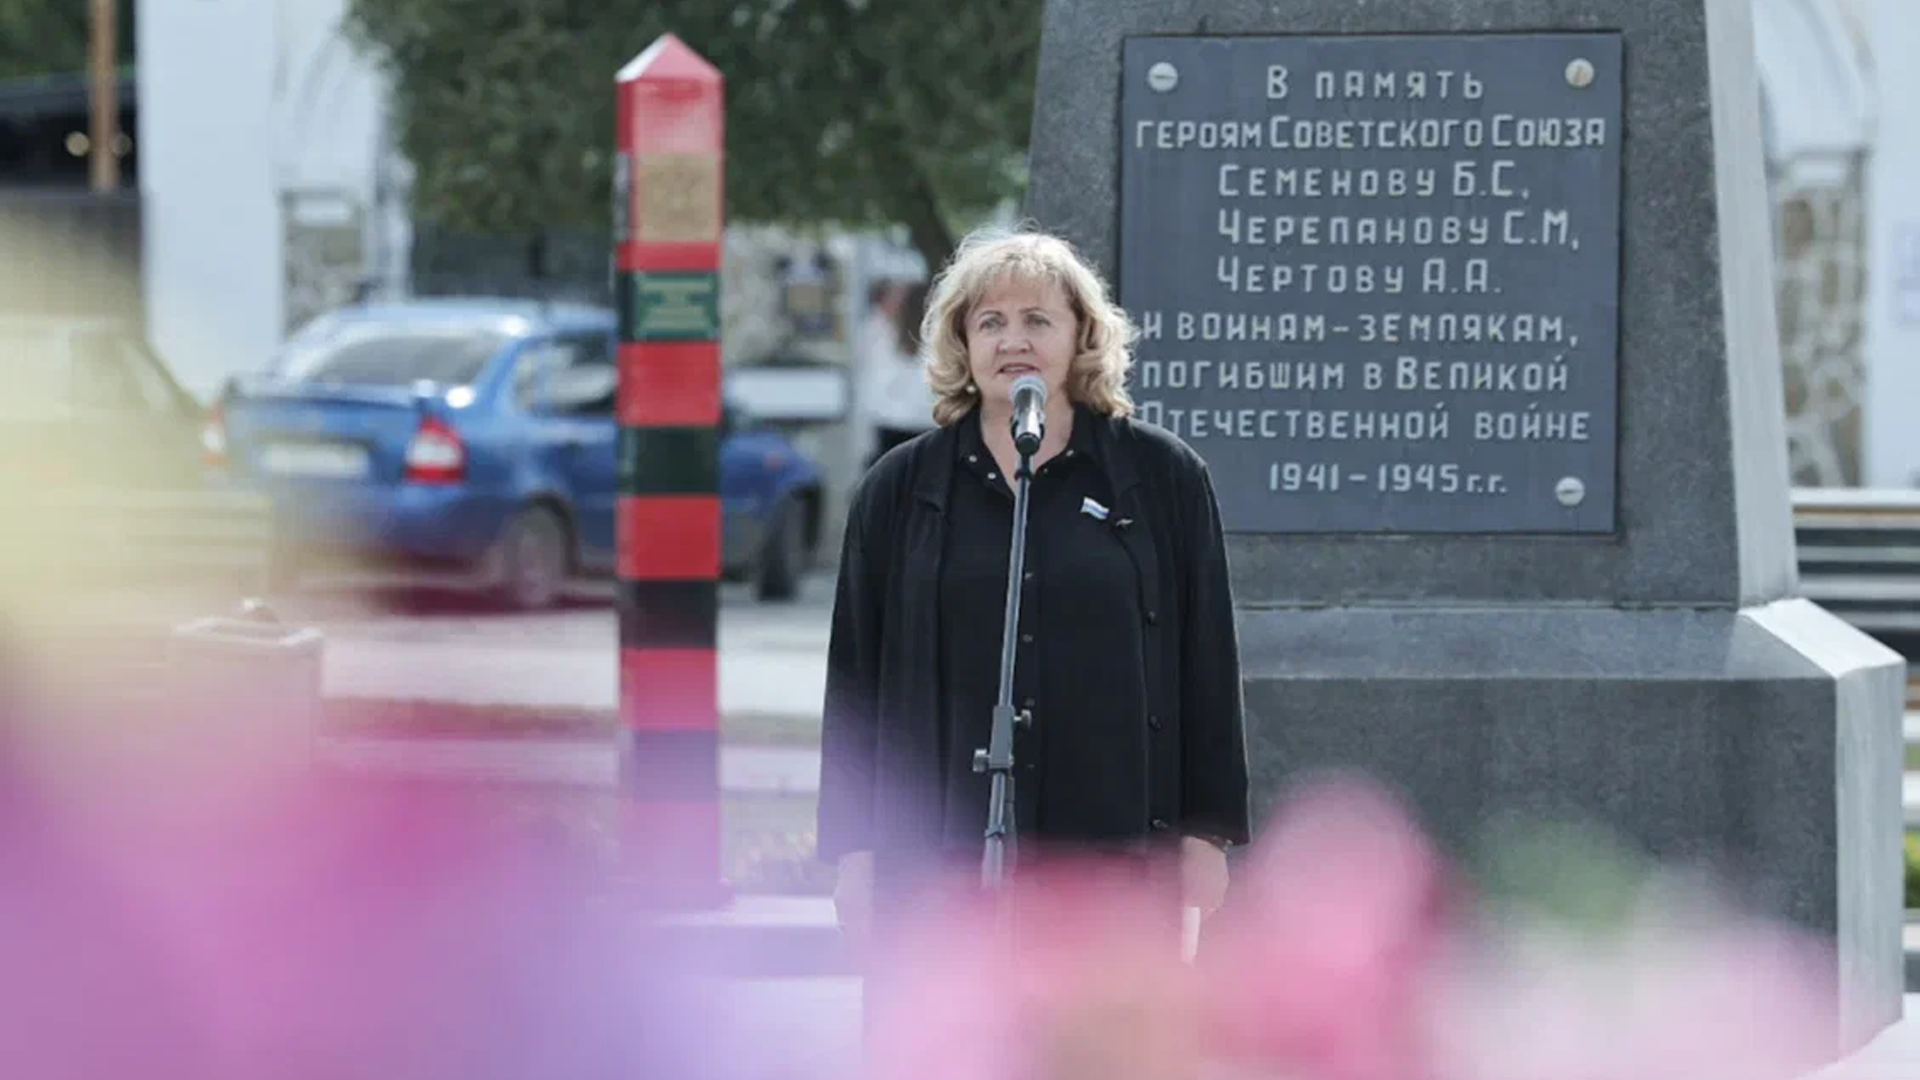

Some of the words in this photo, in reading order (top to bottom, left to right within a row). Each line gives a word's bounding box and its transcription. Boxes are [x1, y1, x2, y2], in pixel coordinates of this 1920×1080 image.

[1266, 64, 1288, 99] В
[1315, 70, 1483, 99] ПАМЯТЬ
[1135, 119, 1262, 149] ГЕРОЯМ
[1269, 113, 1484, 149] СОВЕТСКОГО
[1491, 112, 1606, 147] СОЮЗА
[1218, 162, 1436, 197] СЕМЕНОВУ
[1218, 208, 1489, 245] ЧЕРЕПАНОВУ
[1216, 255, 1404, 294] ЧЕРТОВУ
[1142, 310, 1163, 340] И
[1142, 360, 1345, 390] ПОГИБШИМ
[1363, 361, 1383, 391] В
[1395, 354, 1568, 391] ВЕЛИКОЙ
[1474, 402, 1591, 440] ВОЙНЕ
